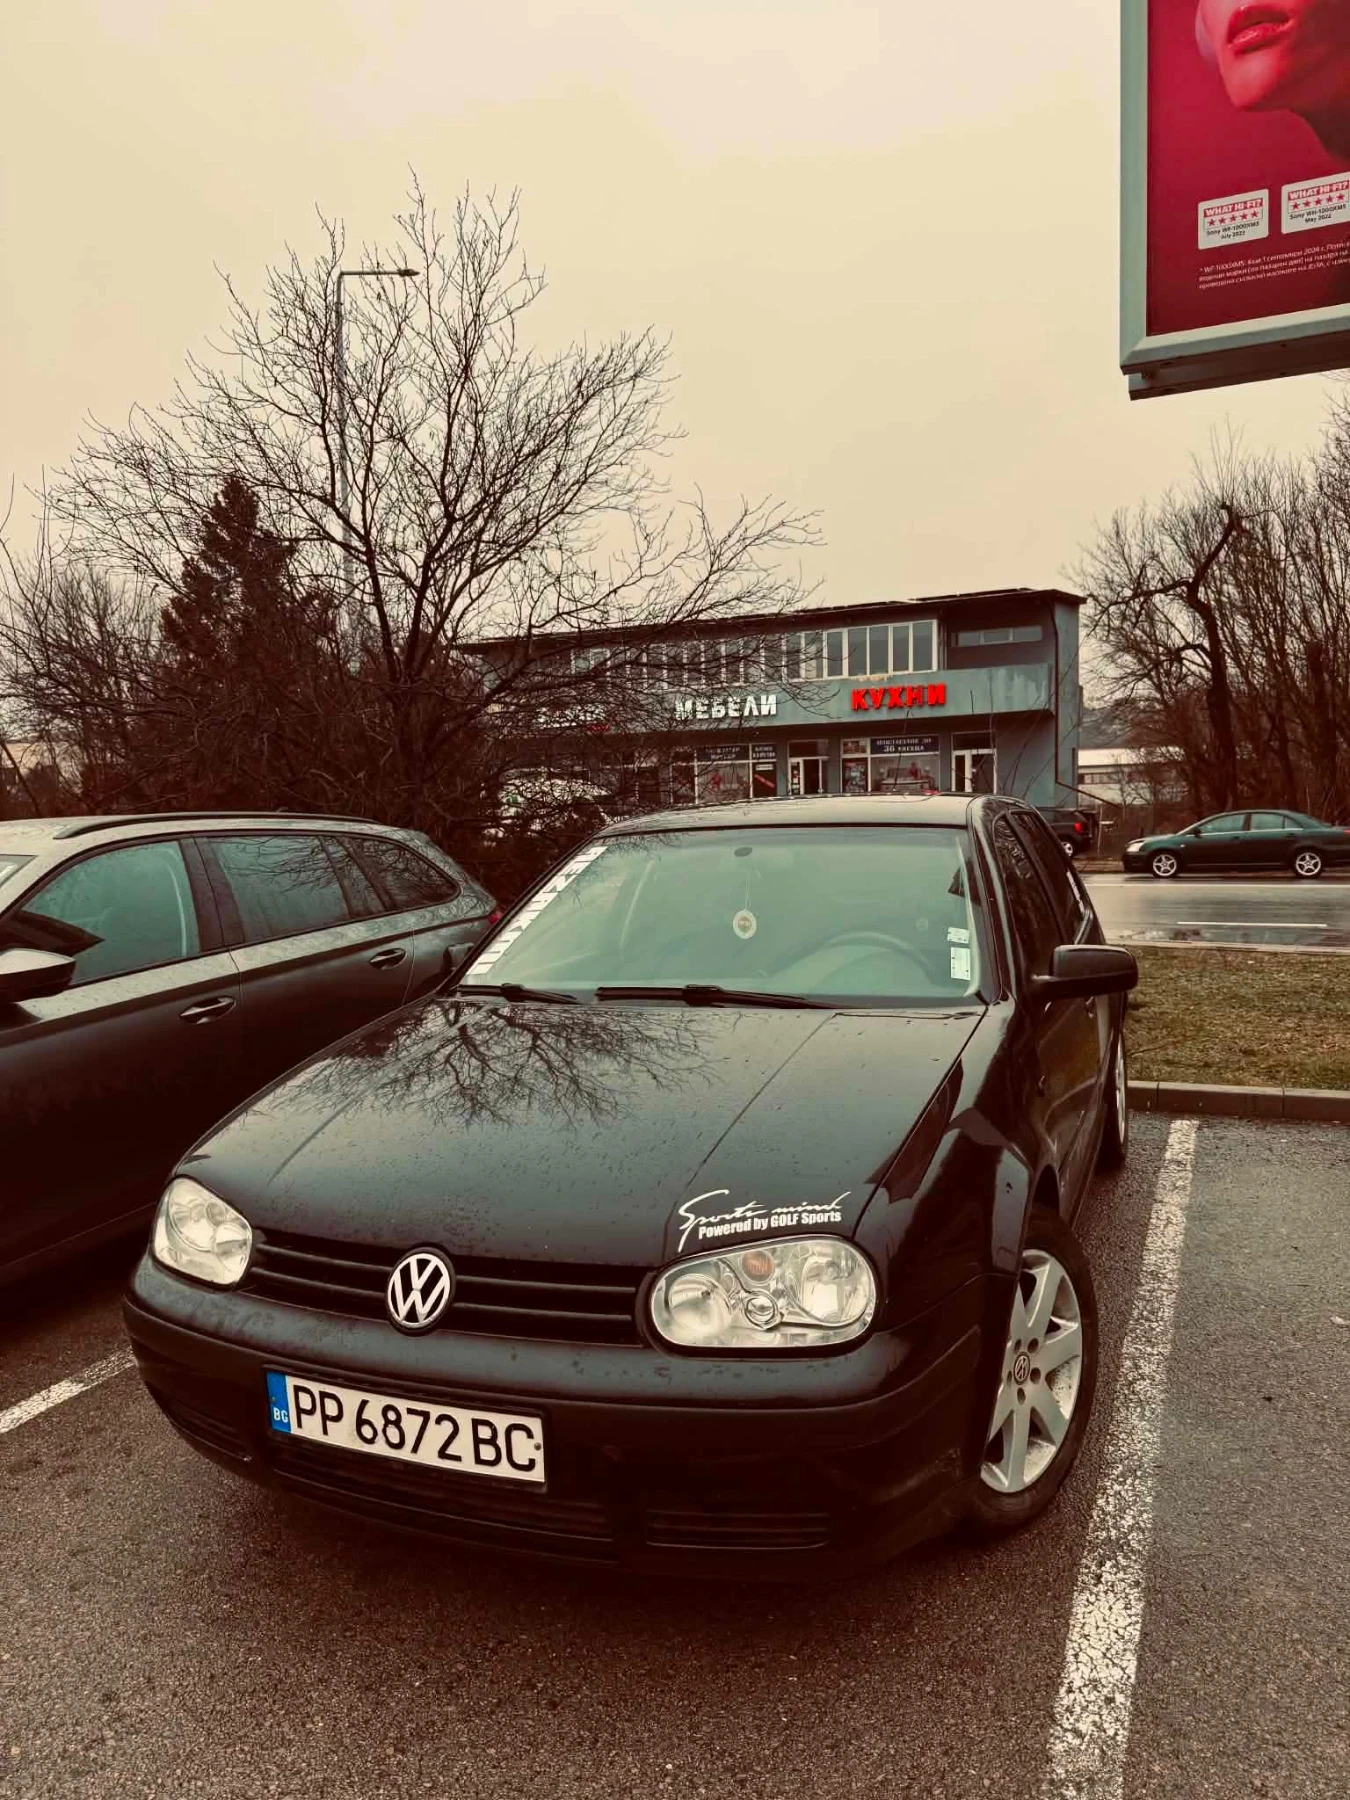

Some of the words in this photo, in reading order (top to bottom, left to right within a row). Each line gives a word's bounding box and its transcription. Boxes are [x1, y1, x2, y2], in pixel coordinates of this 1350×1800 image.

[1290, 188, 1319, 200] WHAT
[1319, 181, 1348, 194] HI-FI?
[1205, 204, 1234, 217] WHAT
[1234, 199, 1262, 211] HI-FI?
[674, 694, 777, 721] МЕБЕЛИ
[851, 683, 946, 711] КУХНИ
[698, 1218, 752, 1240] Powered
[753, 1217, 768, 1231] by
[770, 1213, 799, 1228] GOLF
[801, 1211, 842, 1225] Sports
[272, 1406, 289, 1424] BG
[293, 1384, 344, 1436] PP
[355, 1398, 462, 1463] 6872
[471, 1417, 536, 1473] BC
